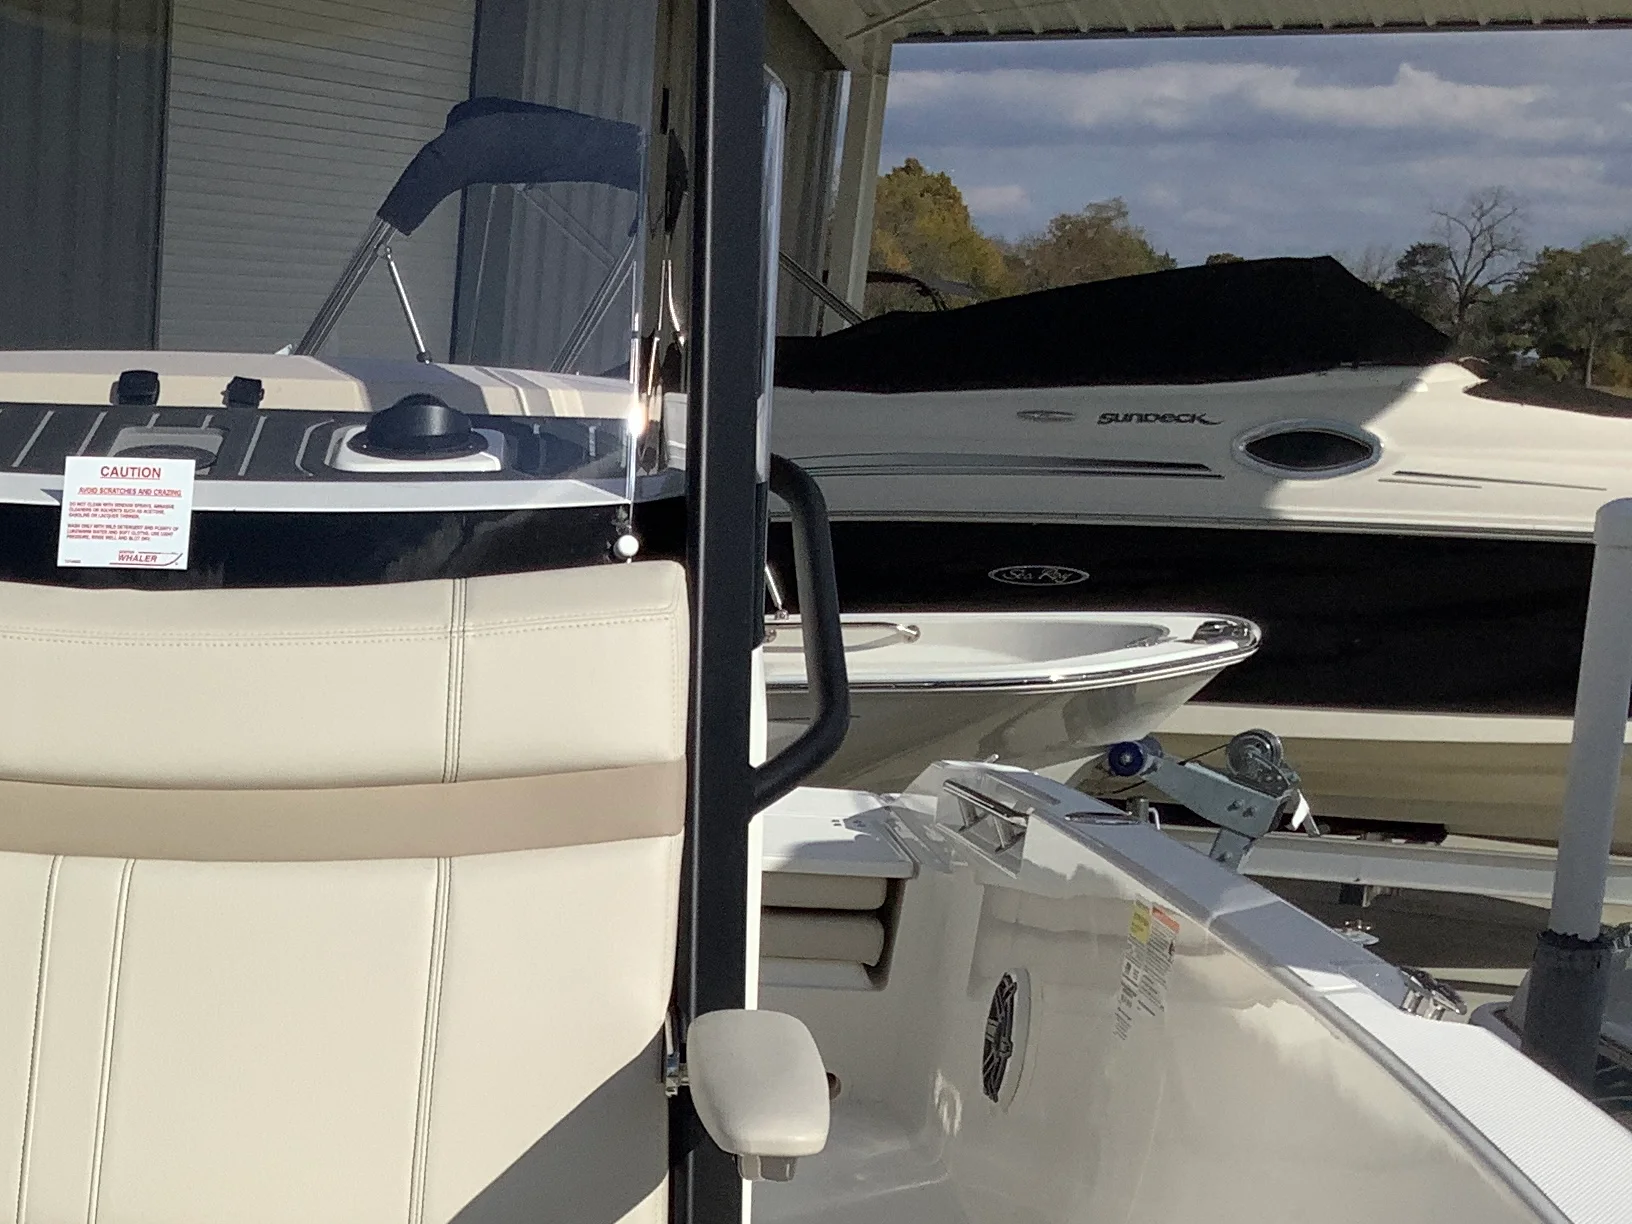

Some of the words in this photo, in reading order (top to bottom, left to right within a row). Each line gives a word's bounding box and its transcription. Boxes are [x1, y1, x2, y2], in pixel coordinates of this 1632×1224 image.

[100, 466, 162, 478] CAUTION
[79, 487, 98, 495] AVOID
[99, 487, 136, 496] SCRATCHES
[138, 488, 152, 496] AND
[153, 489, 182, 497] CRAZING
[118, 554, 158, 563] WHALER
